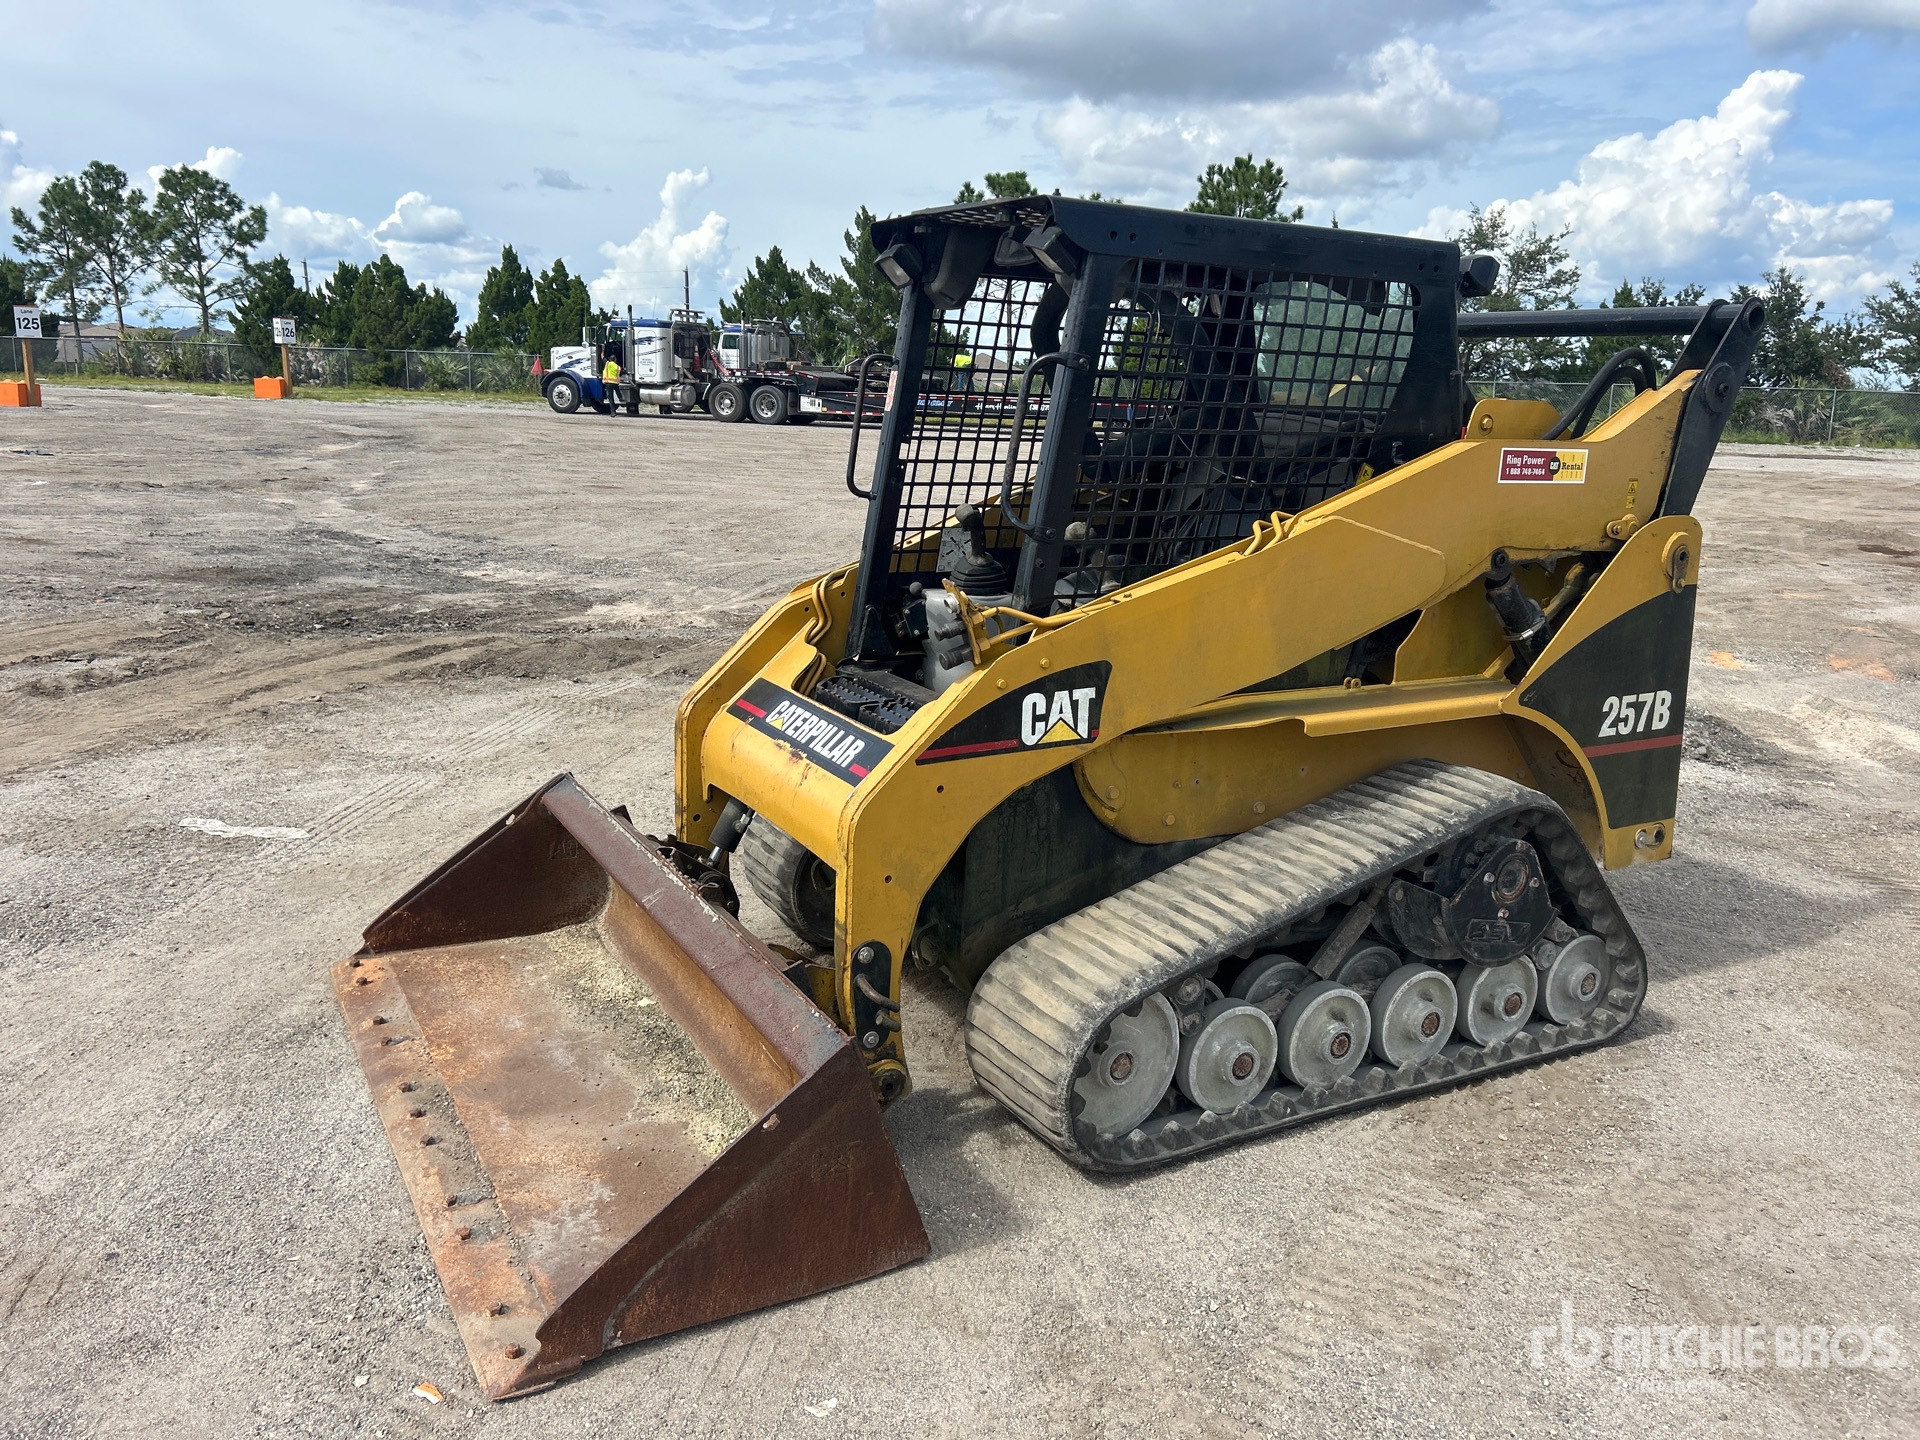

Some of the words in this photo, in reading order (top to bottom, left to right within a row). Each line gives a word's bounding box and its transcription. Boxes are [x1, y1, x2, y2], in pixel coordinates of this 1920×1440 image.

[16, 317, 40, 330] 125
[281, 327, 295, 338] 126
[1506, 454, 1522, 466] Ring
[1522, 454, 1545, 465] Power
[1549, 461, 1560, 470] CAT
[1561, 462, 1583, 471] Rental
[1020, 686, 1097, 746] CAT
[1598, 690, 1672, 738] 257B
[765, 700, 867, 768] CATERPILLAR
